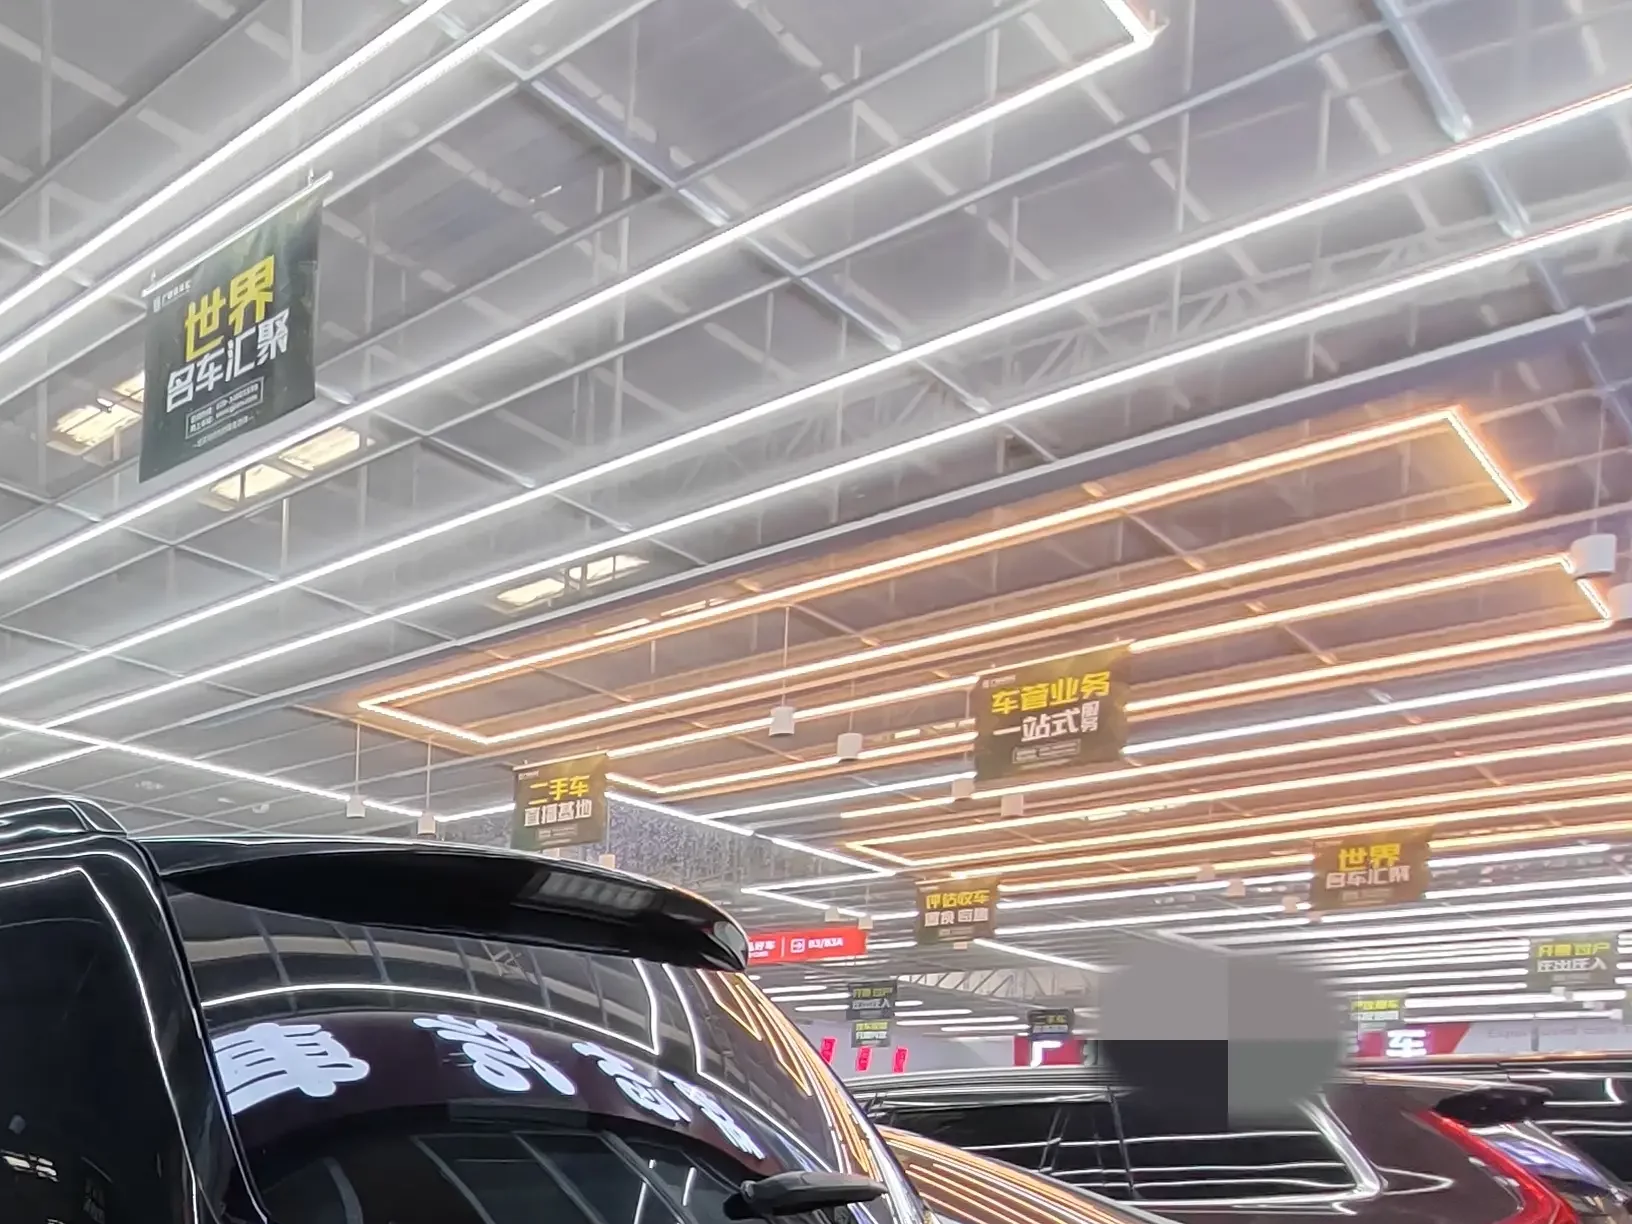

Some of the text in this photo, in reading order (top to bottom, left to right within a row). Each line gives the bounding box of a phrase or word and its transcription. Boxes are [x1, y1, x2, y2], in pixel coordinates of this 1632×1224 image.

[184, 254, 275, 362] 世界
[166, 307, 289, 413] 名车汇聚
[991, 671, 1111, 715] 车管业务
[528, 775, 590, 805] 二手车
[1338, 842, 1402, 872] 世界
